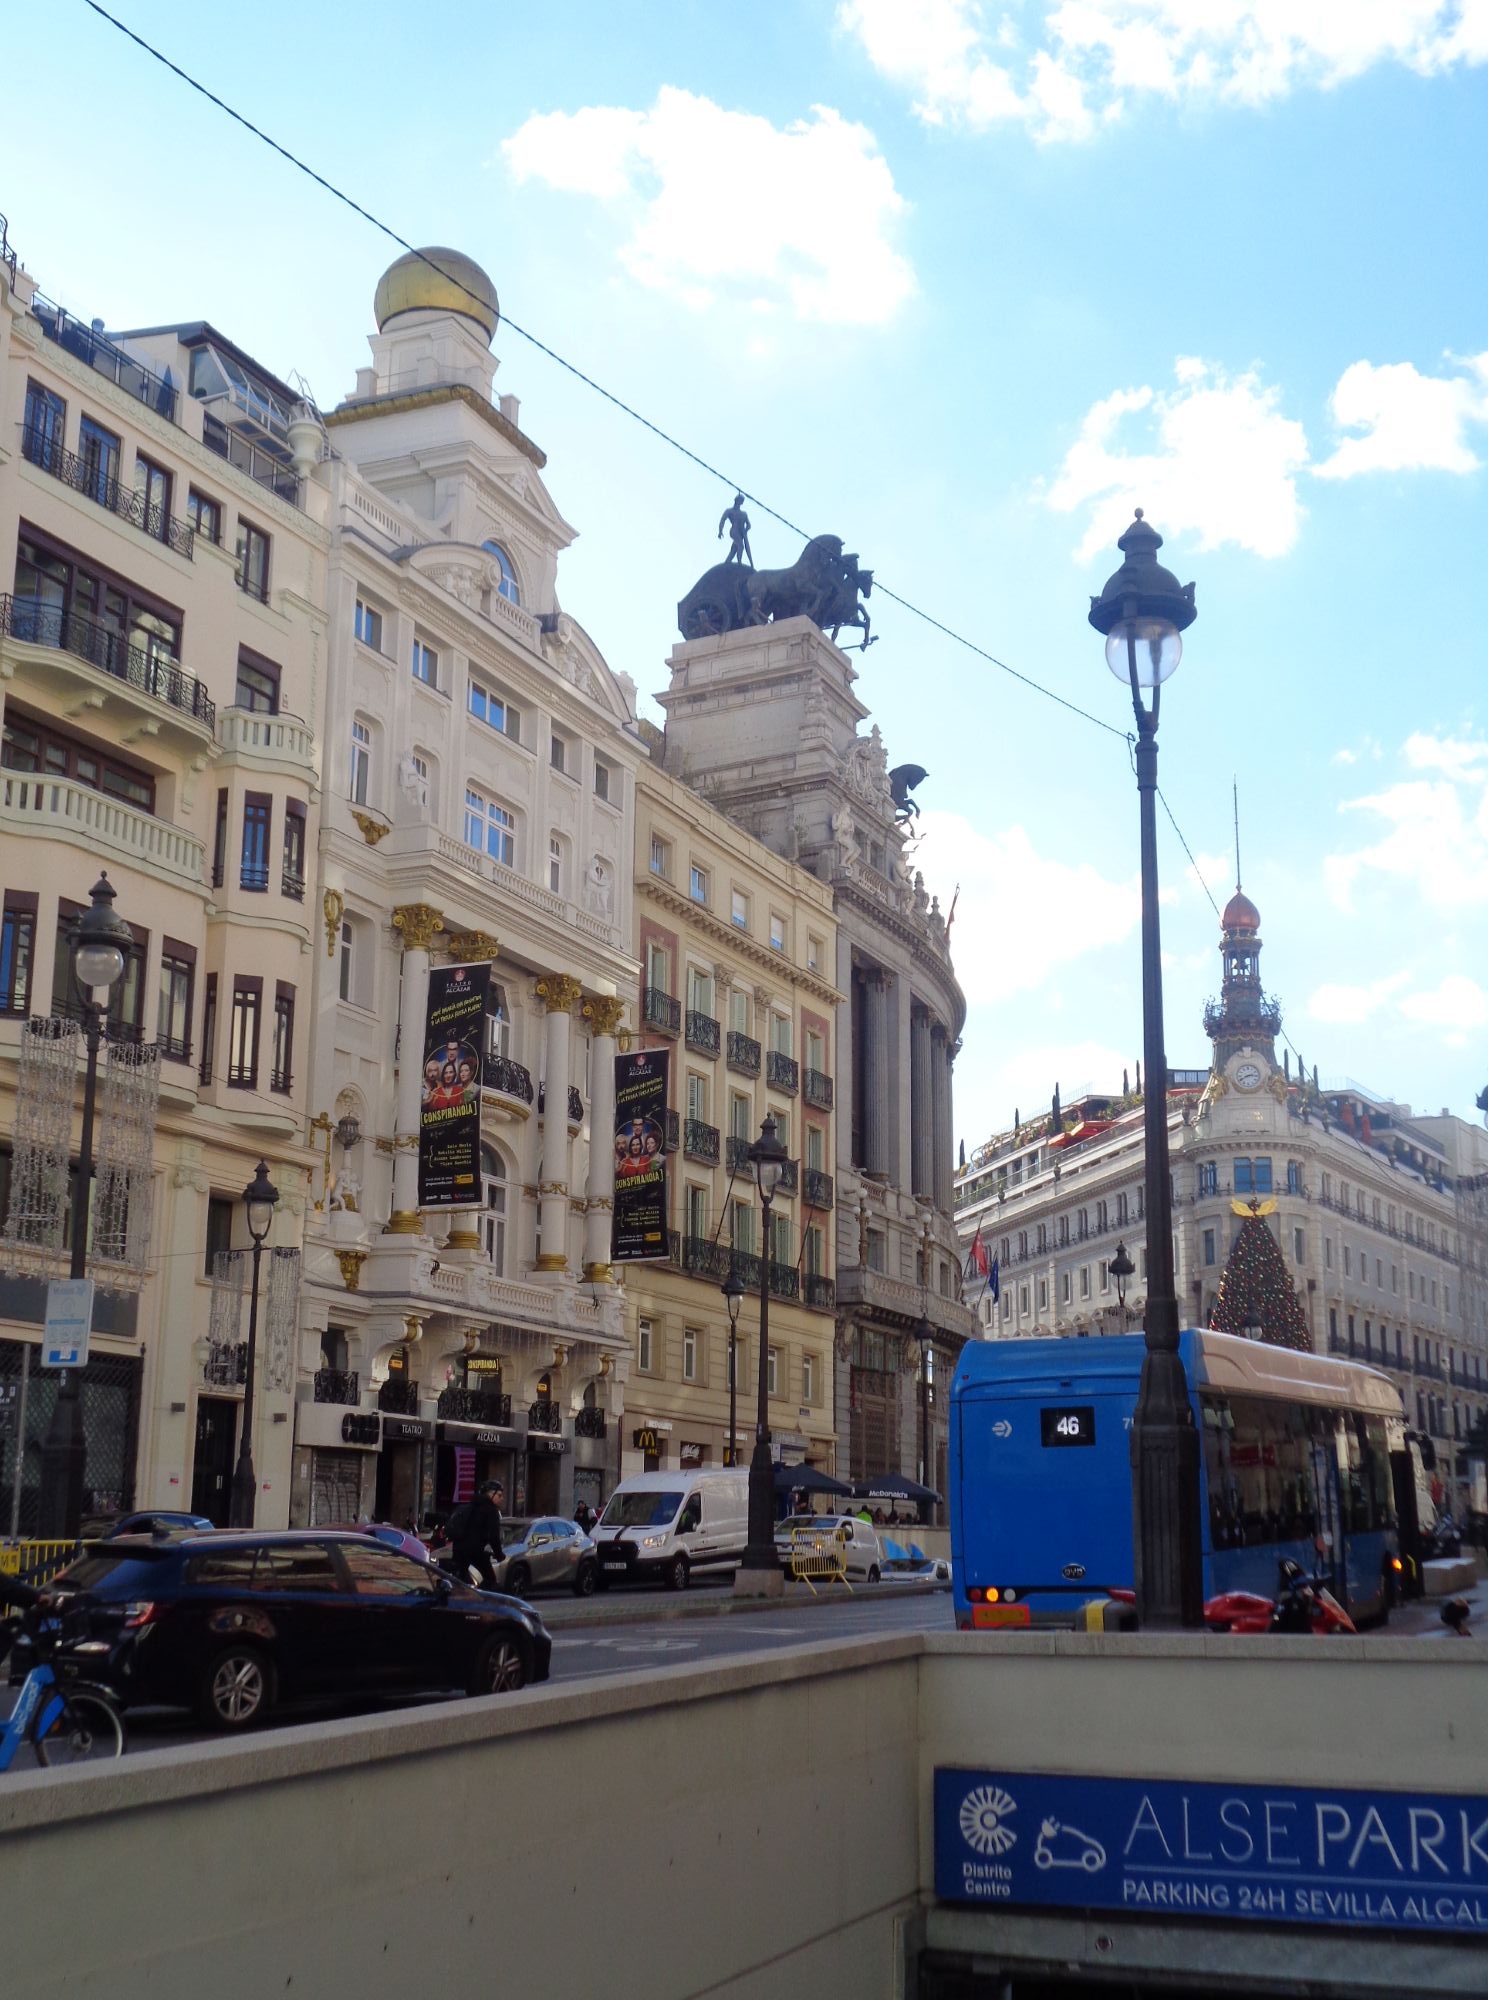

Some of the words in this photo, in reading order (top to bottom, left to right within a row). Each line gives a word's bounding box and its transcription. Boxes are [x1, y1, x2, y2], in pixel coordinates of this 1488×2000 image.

[402, 1424, 423, 1435] TEATRO
[1057, 1416, 1080, 1435] 46
[476, 1431, 501, 1443] ALCÁZAR
[548, 1441, 565, 1452] TEATRO
[962, 1861, 1012, 1880] Distrito
[965, 1879, 1011, 1896] Centro
[1122, 1879, 1231, 1908] PARKING
[1238, 1885, 1286, 1912] 24H
[1294, 1888, 1398, 1919] SEVILLA
